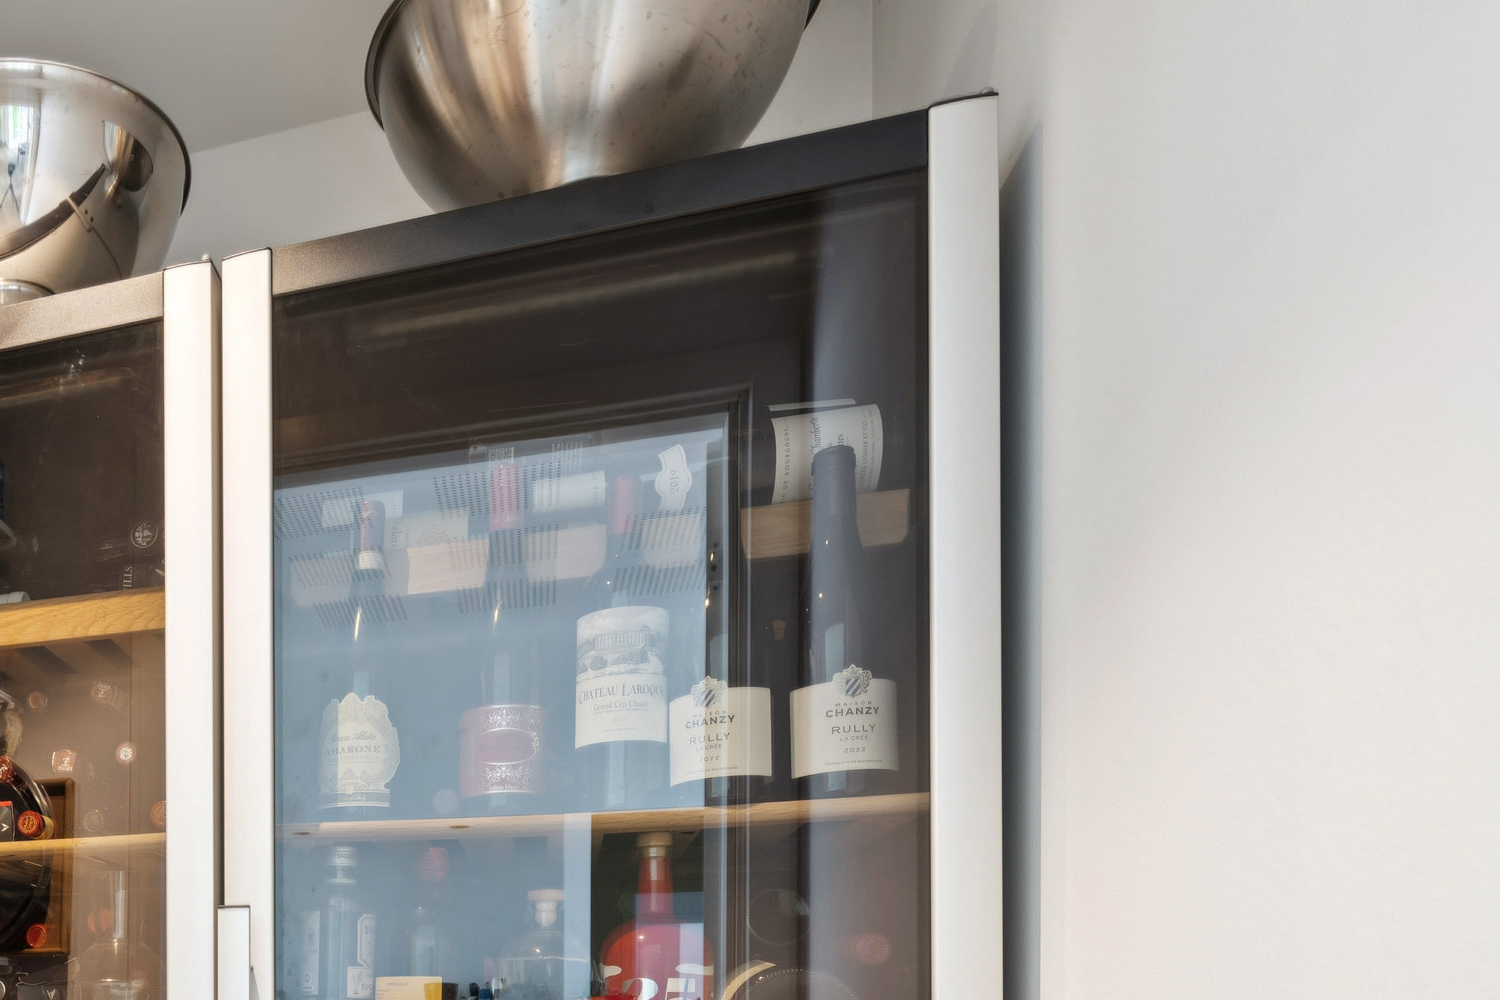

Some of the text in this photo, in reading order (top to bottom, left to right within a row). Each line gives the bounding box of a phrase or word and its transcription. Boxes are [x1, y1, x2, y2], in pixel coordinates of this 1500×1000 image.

[669, 469, 679, 495] 2019
[622, 684, 665, 697] LAROQUE
[835, 700, 872, 708] MAISON
[825, 706, 880, 718] CHANZY
[685, 715, 736, 729] CHANZY
[831, 723, 876, 735] RULLY
[689, 732, 730, 746] RULLY
[844, 746, 866, 754] 2022
[699, 755, 720, 763] 2022
